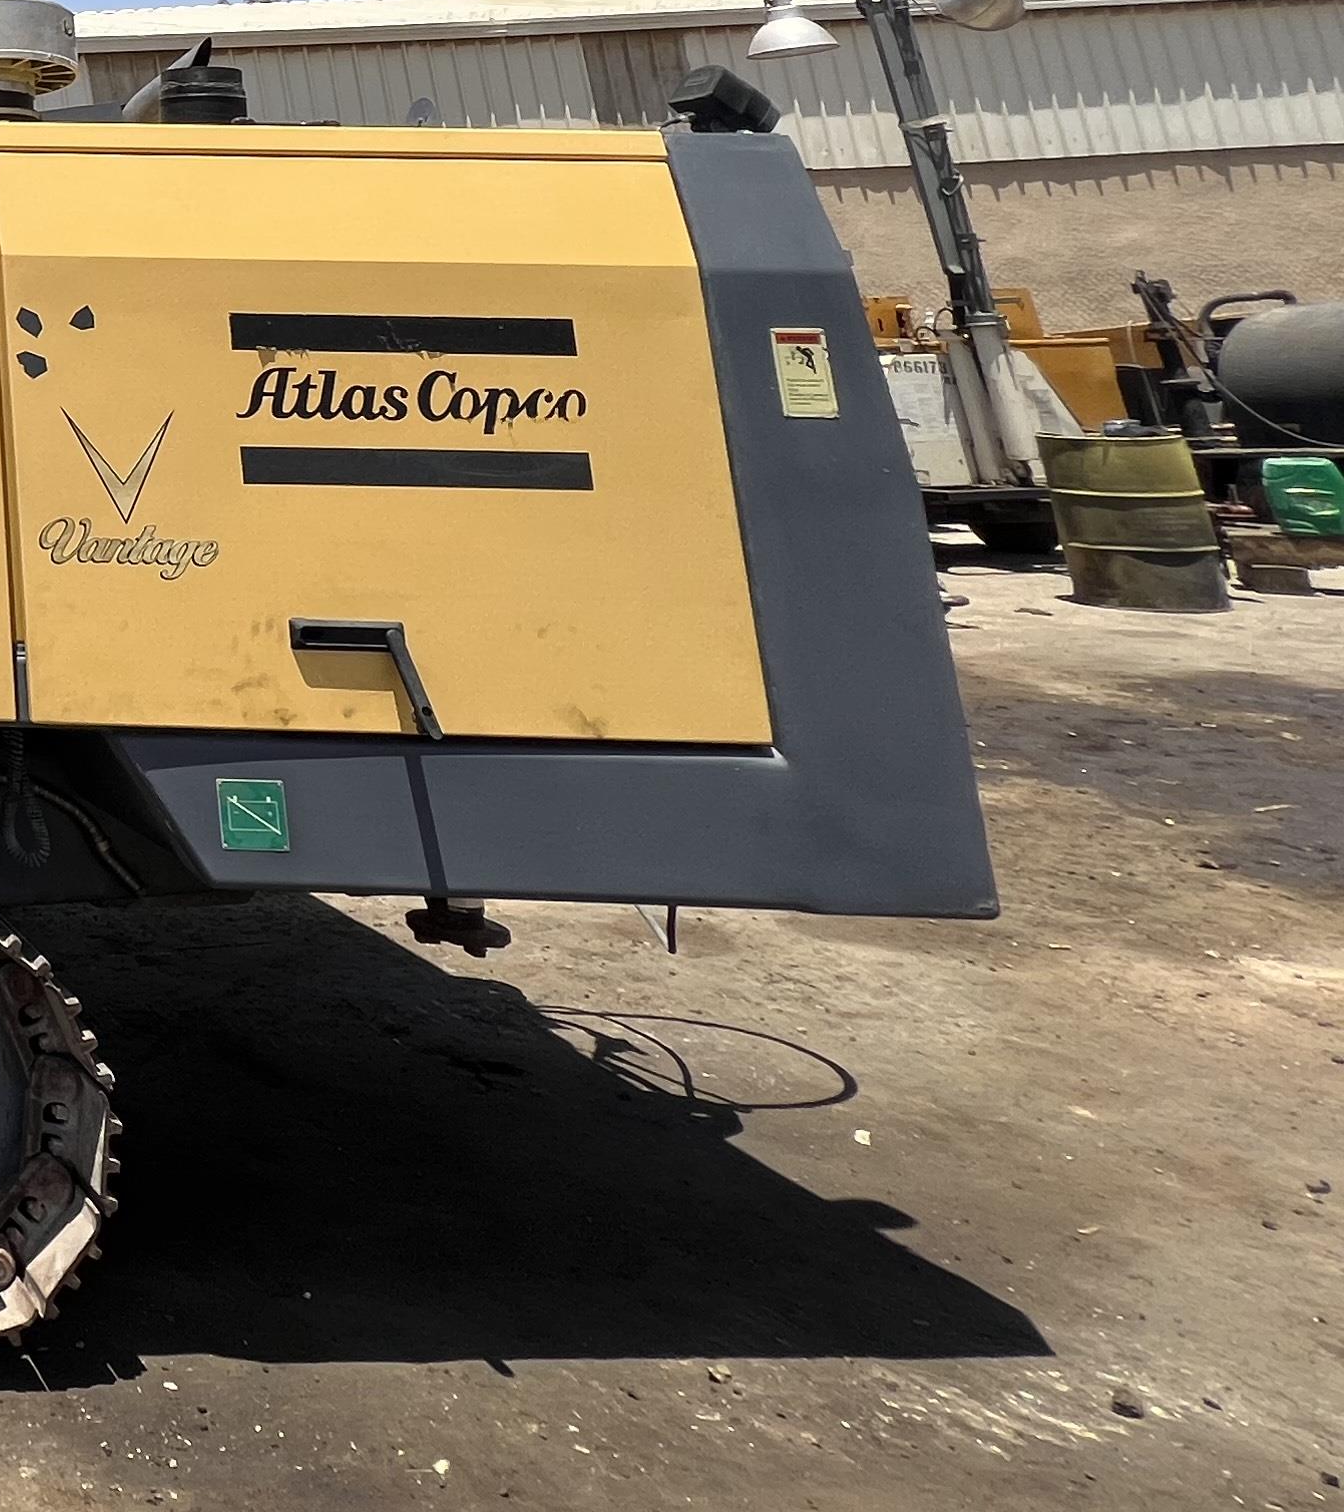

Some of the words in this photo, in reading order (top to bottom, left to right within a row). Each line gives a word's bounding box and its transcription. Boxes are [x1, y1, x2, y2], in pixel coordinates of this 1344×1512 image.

[236, 367, 409, 421] Atlas
[418, 370, 587, 436] Copco
[39, 517, 219, 580] Vantage
